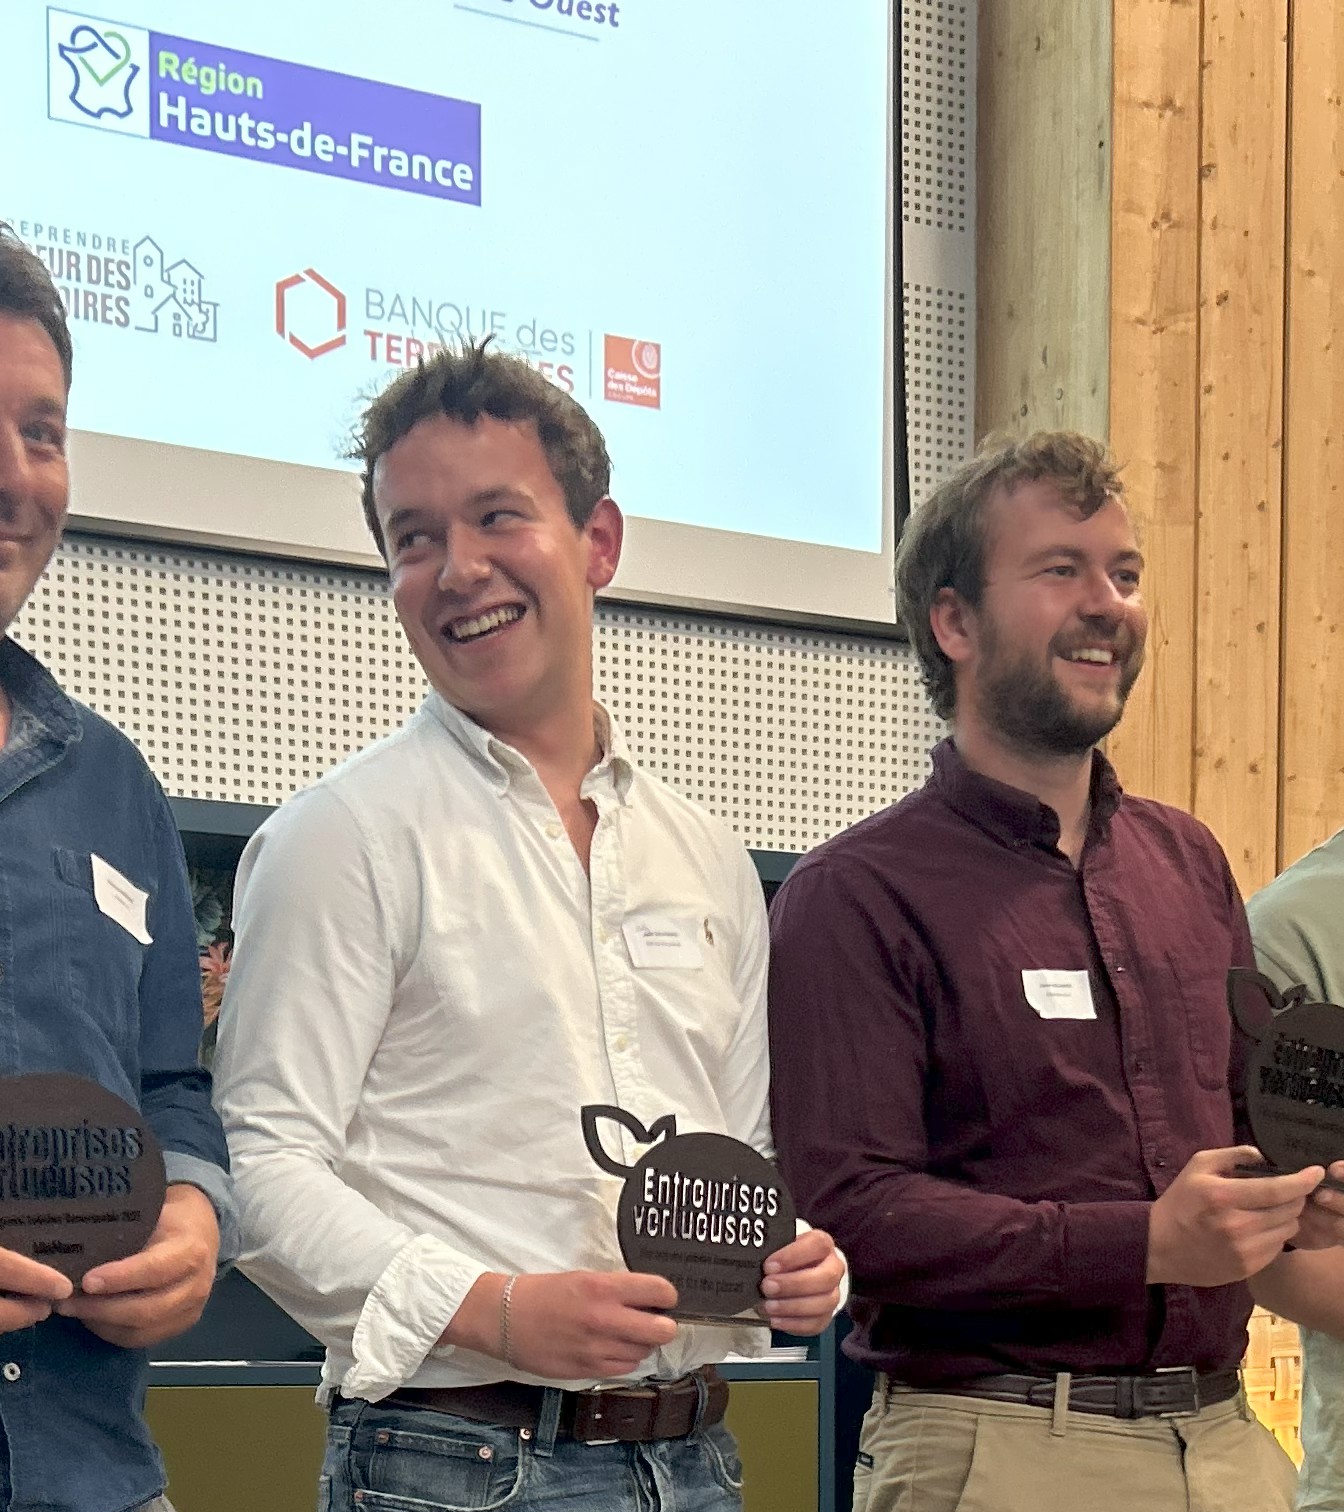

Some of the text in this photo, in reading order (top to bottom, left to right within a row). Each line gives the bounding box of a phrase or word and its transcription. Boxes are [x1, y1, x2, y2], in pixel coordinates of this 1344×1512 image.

[158, 50, 264, 99] Région
[158, 92, 474, 191] Hauts-de-France
[7, 217, 130, 256] EPRENDRE
[86, 253, 131, 291] DES
[365, 287, 575, 356] BANQUE des
[643, 1167, 781, 1217] Entreprises
[633, 1200, 765, 1247] vertueuses
